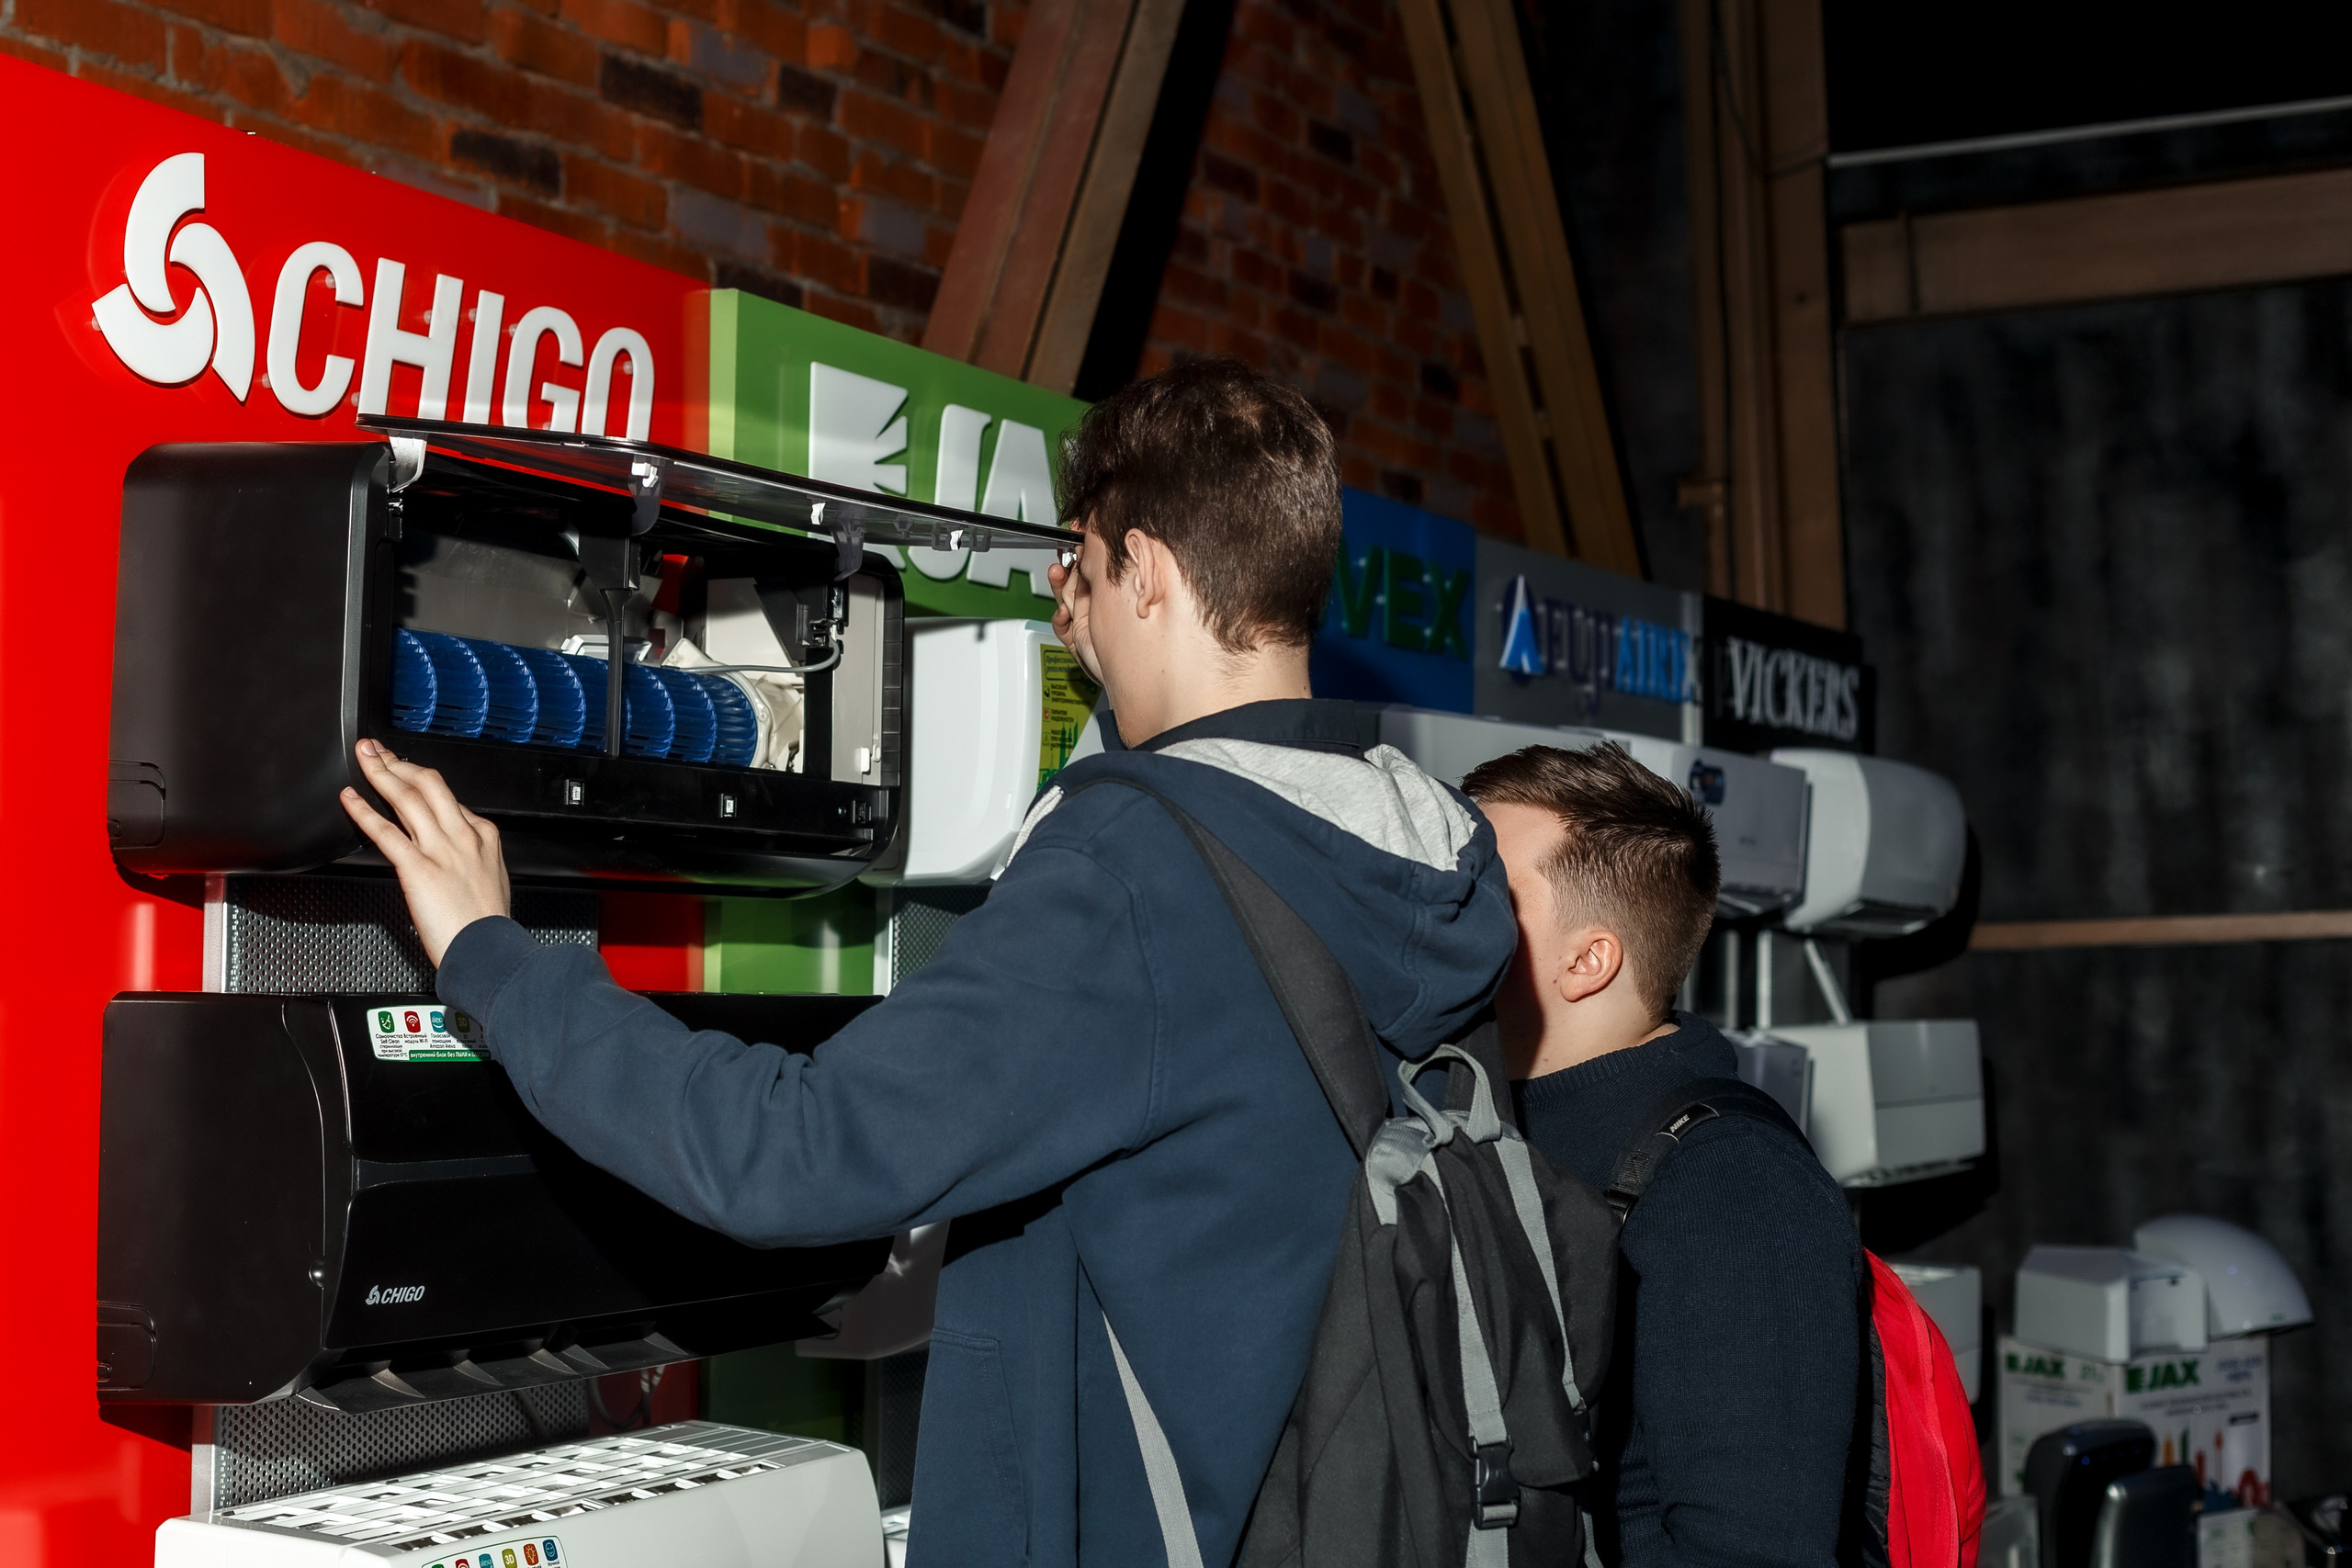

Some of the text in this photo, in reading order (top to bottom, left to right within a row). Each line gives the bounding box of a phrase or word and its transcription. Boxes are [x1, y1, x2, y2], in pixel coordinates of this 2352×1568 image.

[266, 241, 655, 442] CHIGO
[808, 361, 1058, 599] EJA
[1318, 538, 1472, 660] VEX
[1725, 634, 1861, 740] VICKERS
[457, 1017, 468, 1028] 3D
[1669, 1113, 1690, 1134] NIKE
[380, 1285, 425, 1304] CHIGO
[2126, 1359, 2201, 1394] EJAX
[504, 1554, 514, 1564] 3D
